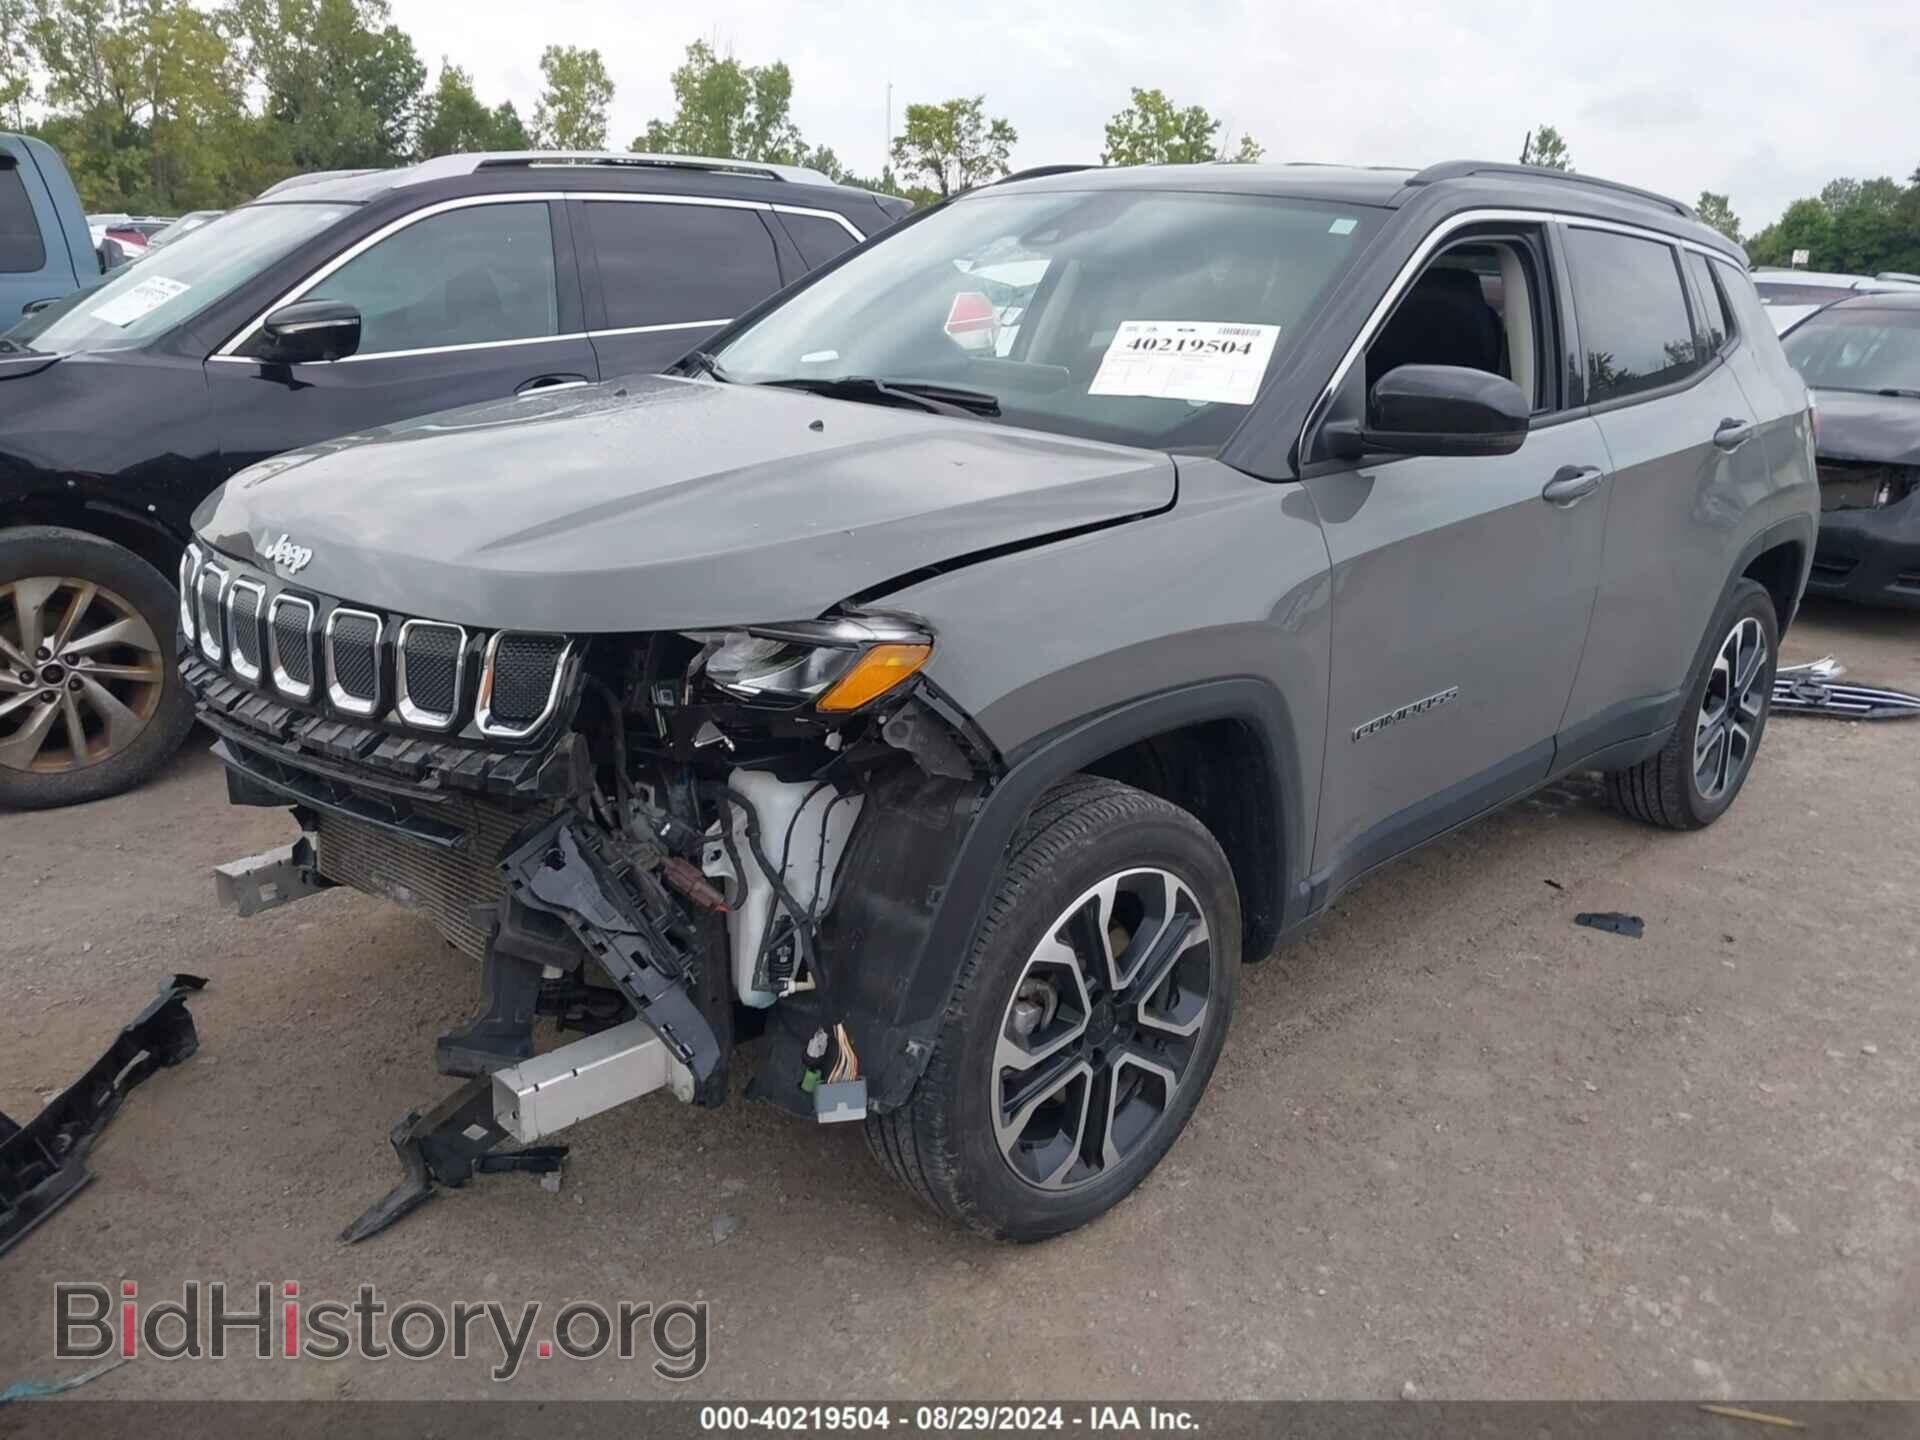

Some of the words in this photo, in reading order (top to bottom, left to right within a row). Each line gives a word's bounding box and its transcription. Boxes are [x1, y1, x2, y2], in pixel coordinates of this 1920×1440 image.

[1126, 337, 1253, 355] 40219504
[264, 533, 313, 574] Jeep
[1352, 686, 1458, 741] COMPASS
